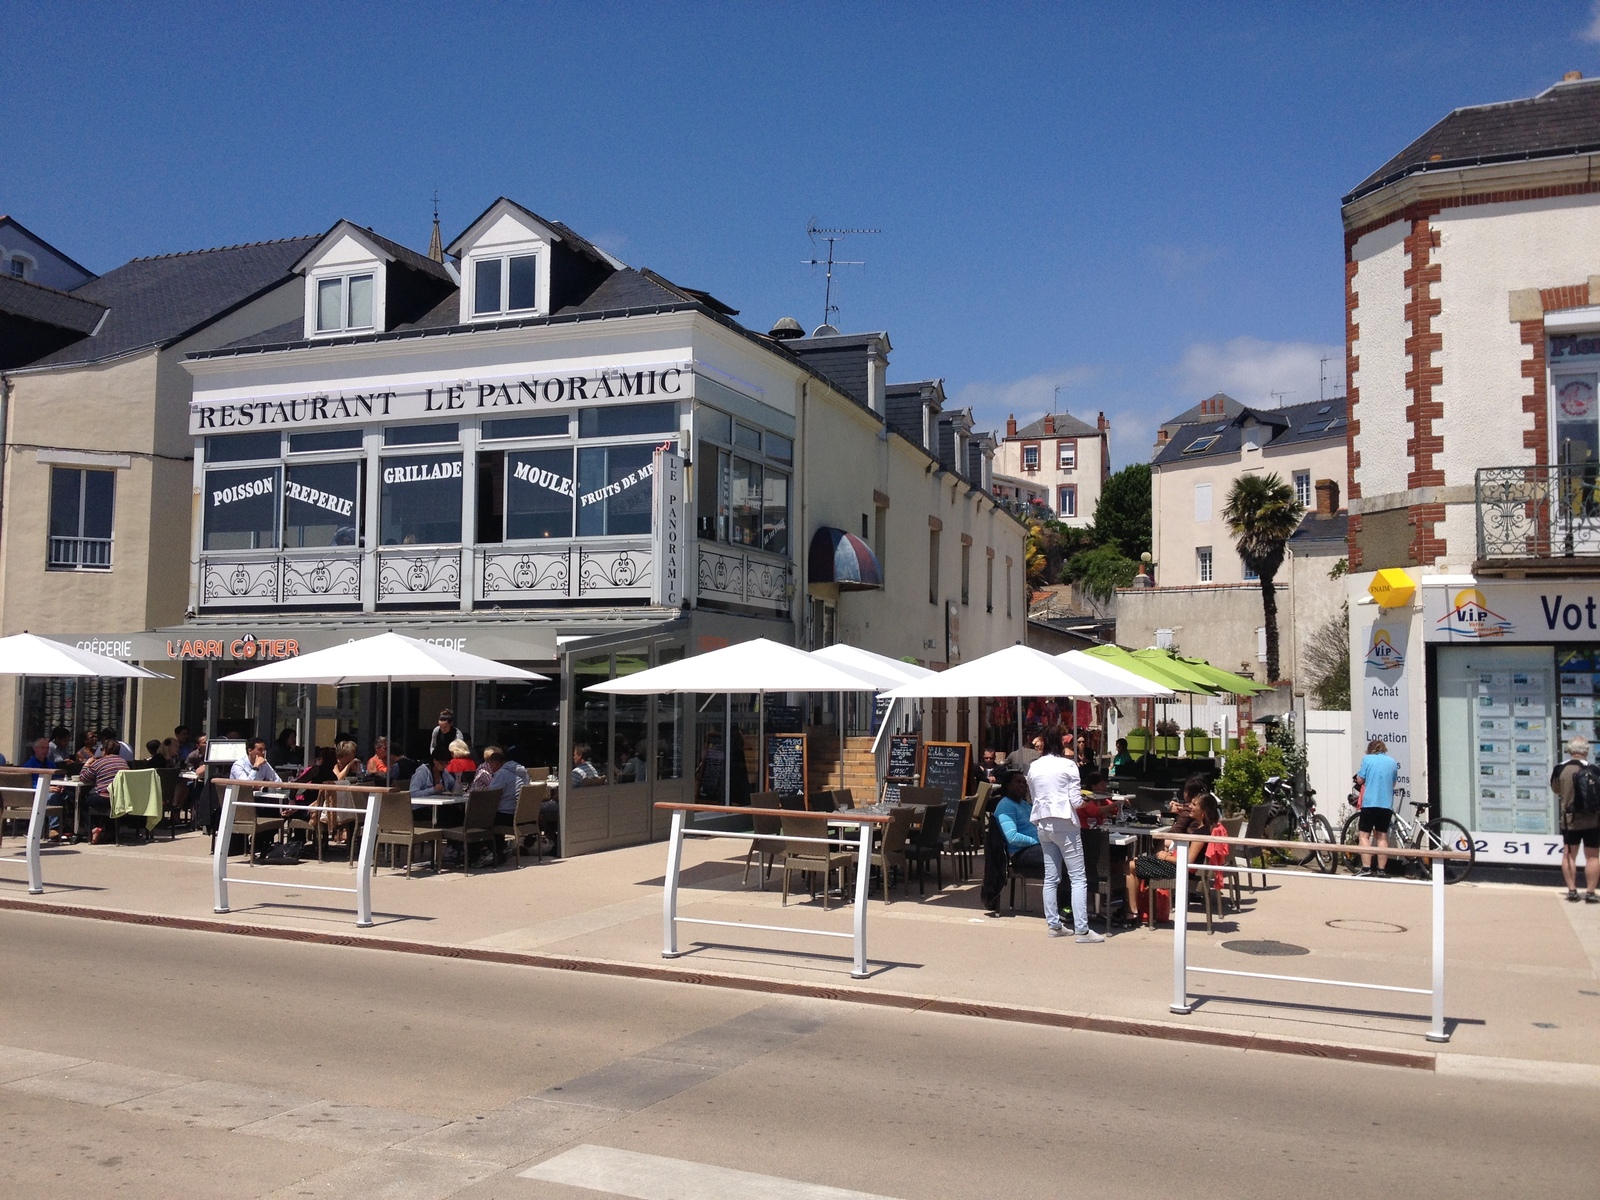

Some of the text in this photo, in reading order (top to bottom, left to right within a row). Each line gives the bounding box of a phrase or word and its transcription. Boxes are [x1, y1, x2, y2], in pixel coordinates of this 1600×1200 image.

[198, 367, 682, 429] RESTAURANT LE PANORAMIC
[383, 461, 462, 485] GRILLADE
[513, 461, 581, 499] MOULES
[580, 462, 655, 507] FRUITS DE ME
[212, 476, 274, 507] POISSON
[284, 480, 354, 517] CREPERIE
[667, 457, 677, 604] LE PANORAMIC
[1370, 585, 1391, 594] FNAIM
[1540, 595, 1598, 630] Vot
[166, 639, 223, 658] L'ABRI
[1371, 685, 1399, 697] Achat
[1372, 708, 1399, 720] Vente
[1366, 730, 1407, 743] Location
[1455, 839, 1489, 853] 02
[1503, 841, 1531, 855] 51
